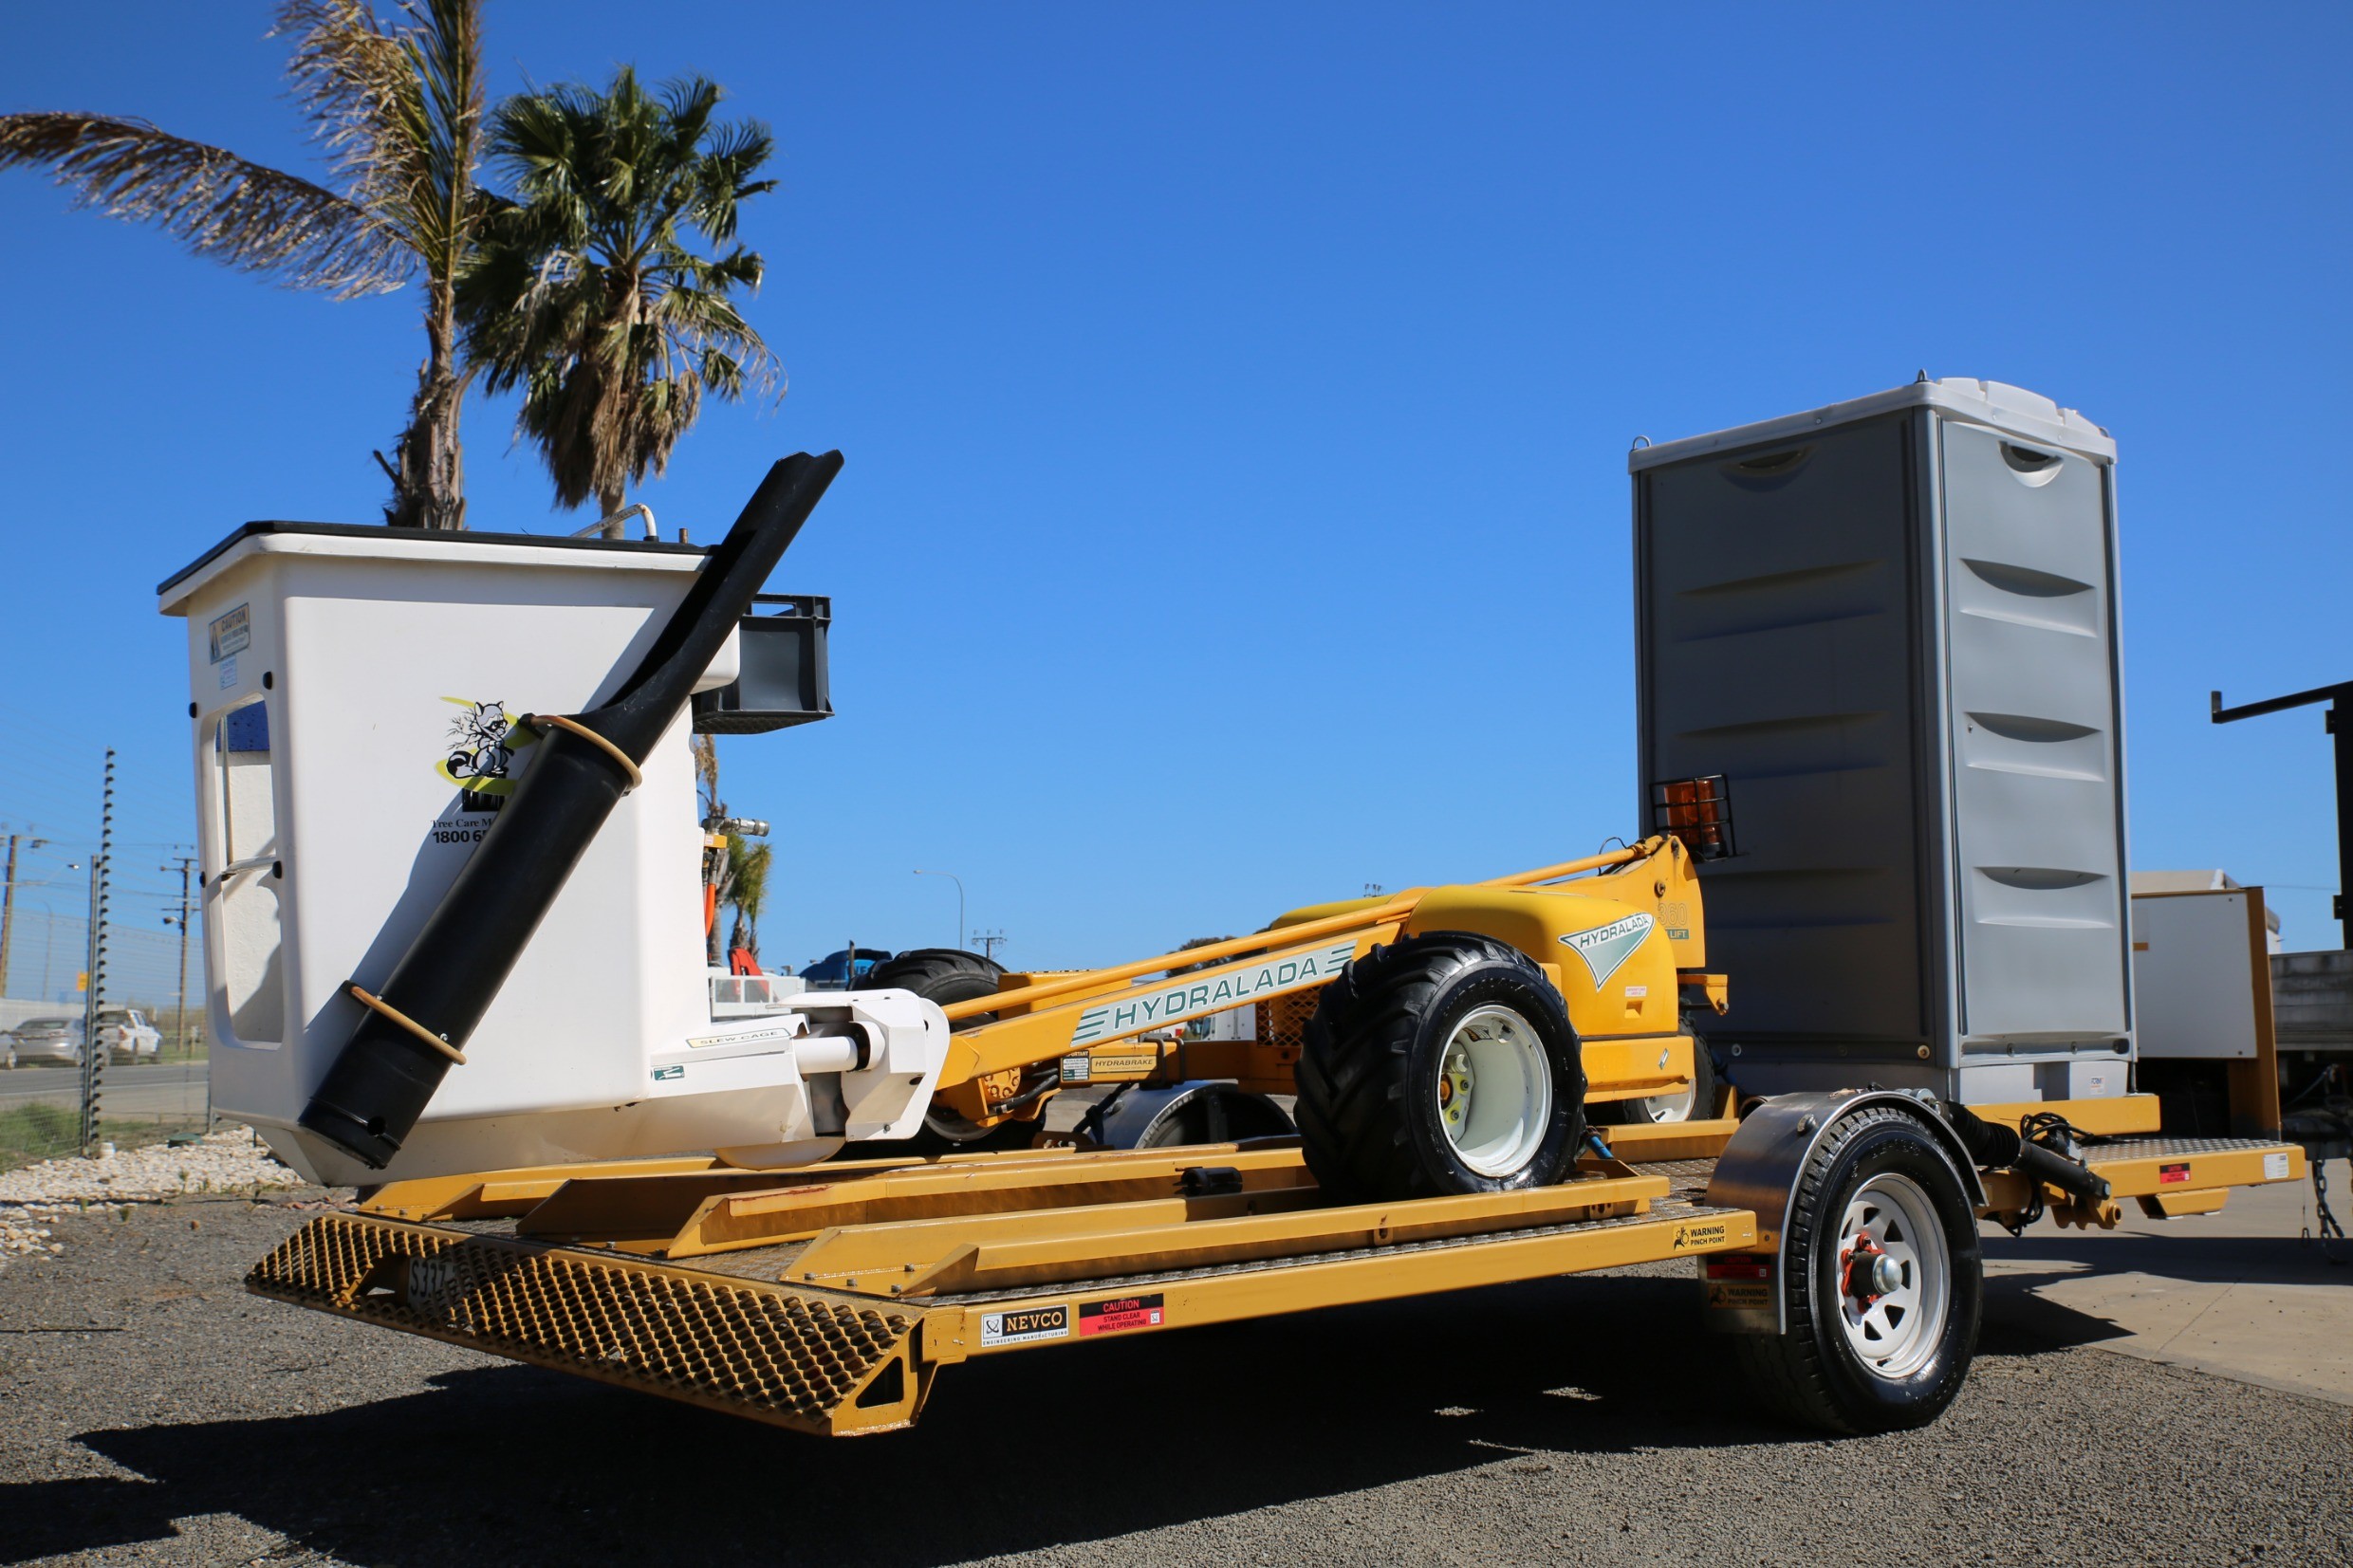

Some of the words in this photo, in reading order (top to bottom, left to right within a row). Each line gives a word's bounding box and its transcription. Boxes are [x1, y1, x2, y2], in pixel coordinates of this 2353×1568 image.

[221, 608, 246, 633] CAUTION
[431, 819, 454, 828] Tree
[455, 818, 479, 828] Care
[433, 830, 470, 844] 1800
[1658, 902, 1688, 926] 360
[1580, 915, 1649, 949] HYDRALADA
[1670, 930, 1688, 939] LIFT
[1114, 956, 1318, 1030] HYDRALADA
[699, 1036, 737, 1045] SLEW
[740, 1030, 779, 1040] CAGE
[1094, 1059, 1153, 1067] HYDRABRAKE
[1690, 1225, 1725, 1238] WARNING
[1690, 1238, 1708, 1246] PINCH
[1708, 1236, 1725, 1245] POINT
[1728, 1287, 1768, 1297] WARNING
[1102, 1299, 1139, 1313] CAUTION
[1006, 1311, 1063, 1332] NEVCO
[1103, 1314, 1122, 1323] STAND
[1122, 1311, 1140, 1320] CLEAR
[1097, 1323, 1116, 1332] WHILE
[1116, 1319, 1146, 1329] OPERATING
[982, 1337, 1021, 1346] ENGINEERING
